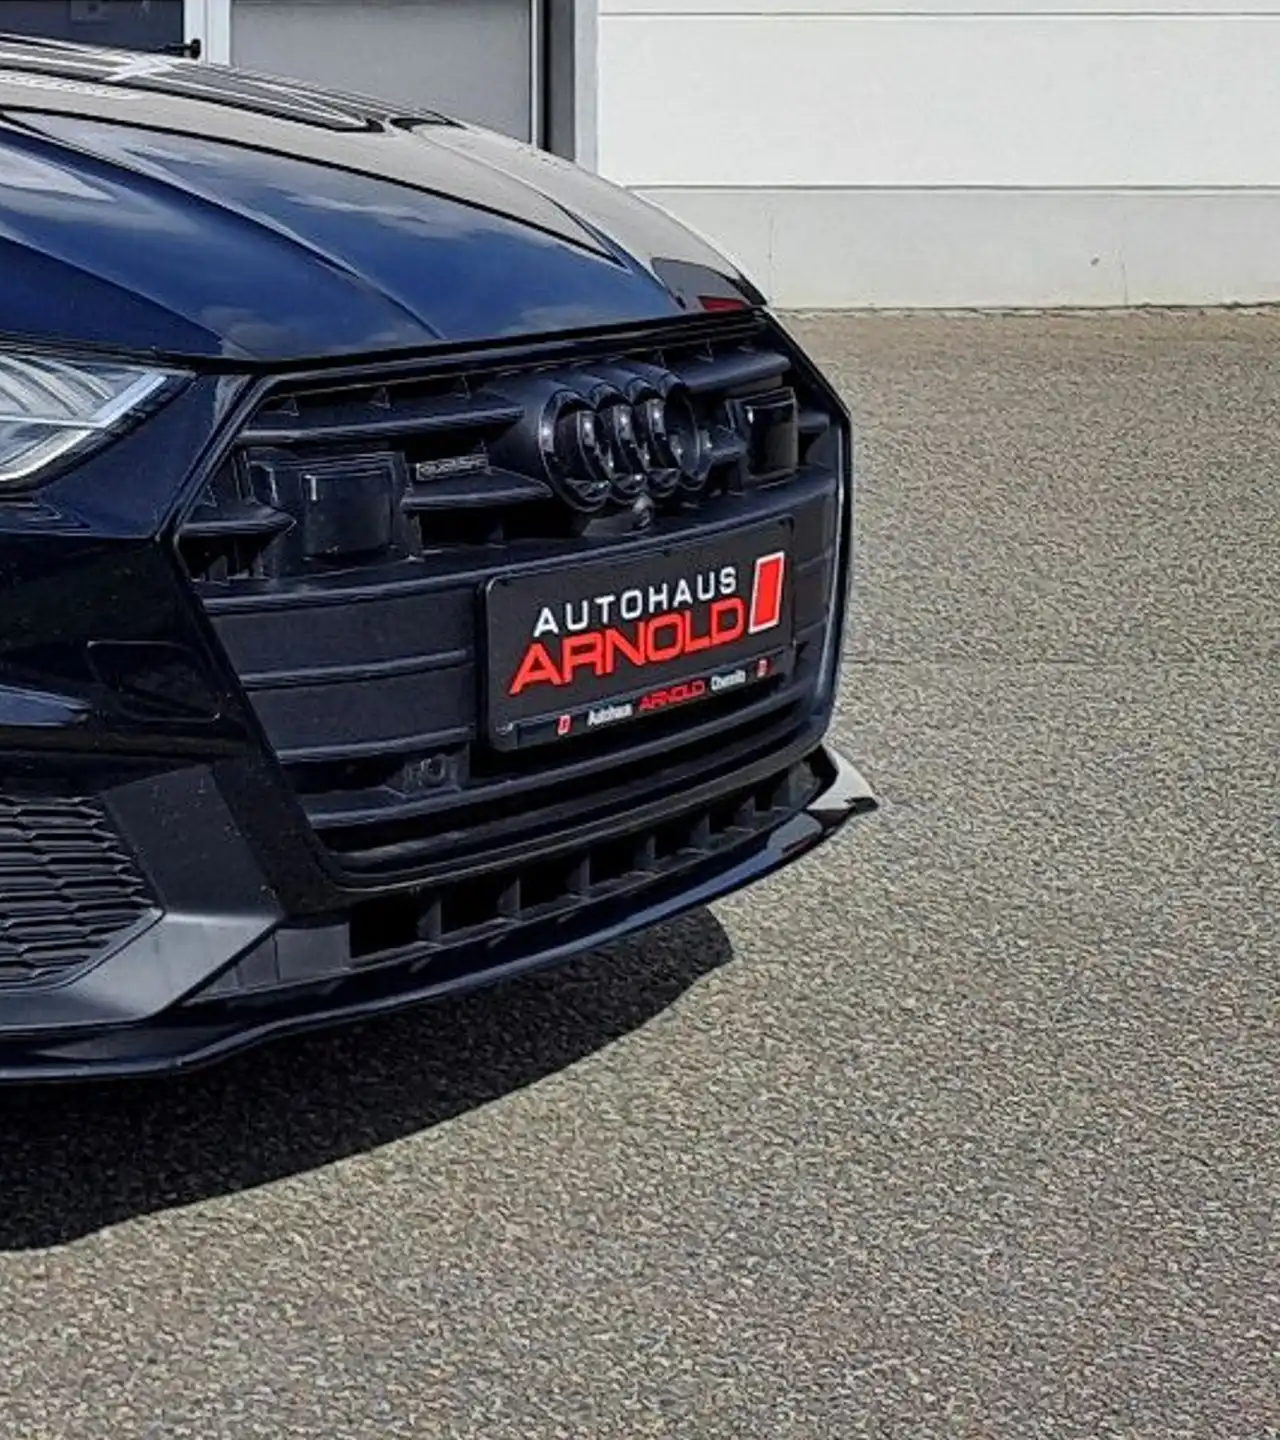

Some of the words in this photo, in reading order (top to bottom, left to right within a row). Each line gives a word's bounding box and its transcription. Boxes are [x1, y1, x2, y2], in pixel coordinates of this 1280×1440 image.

[533, 566, 738, 638] AUTOHAUS
[508, 596, 745, 696] ARNOLD
[639, 680, 707, 711] ARNOLD
